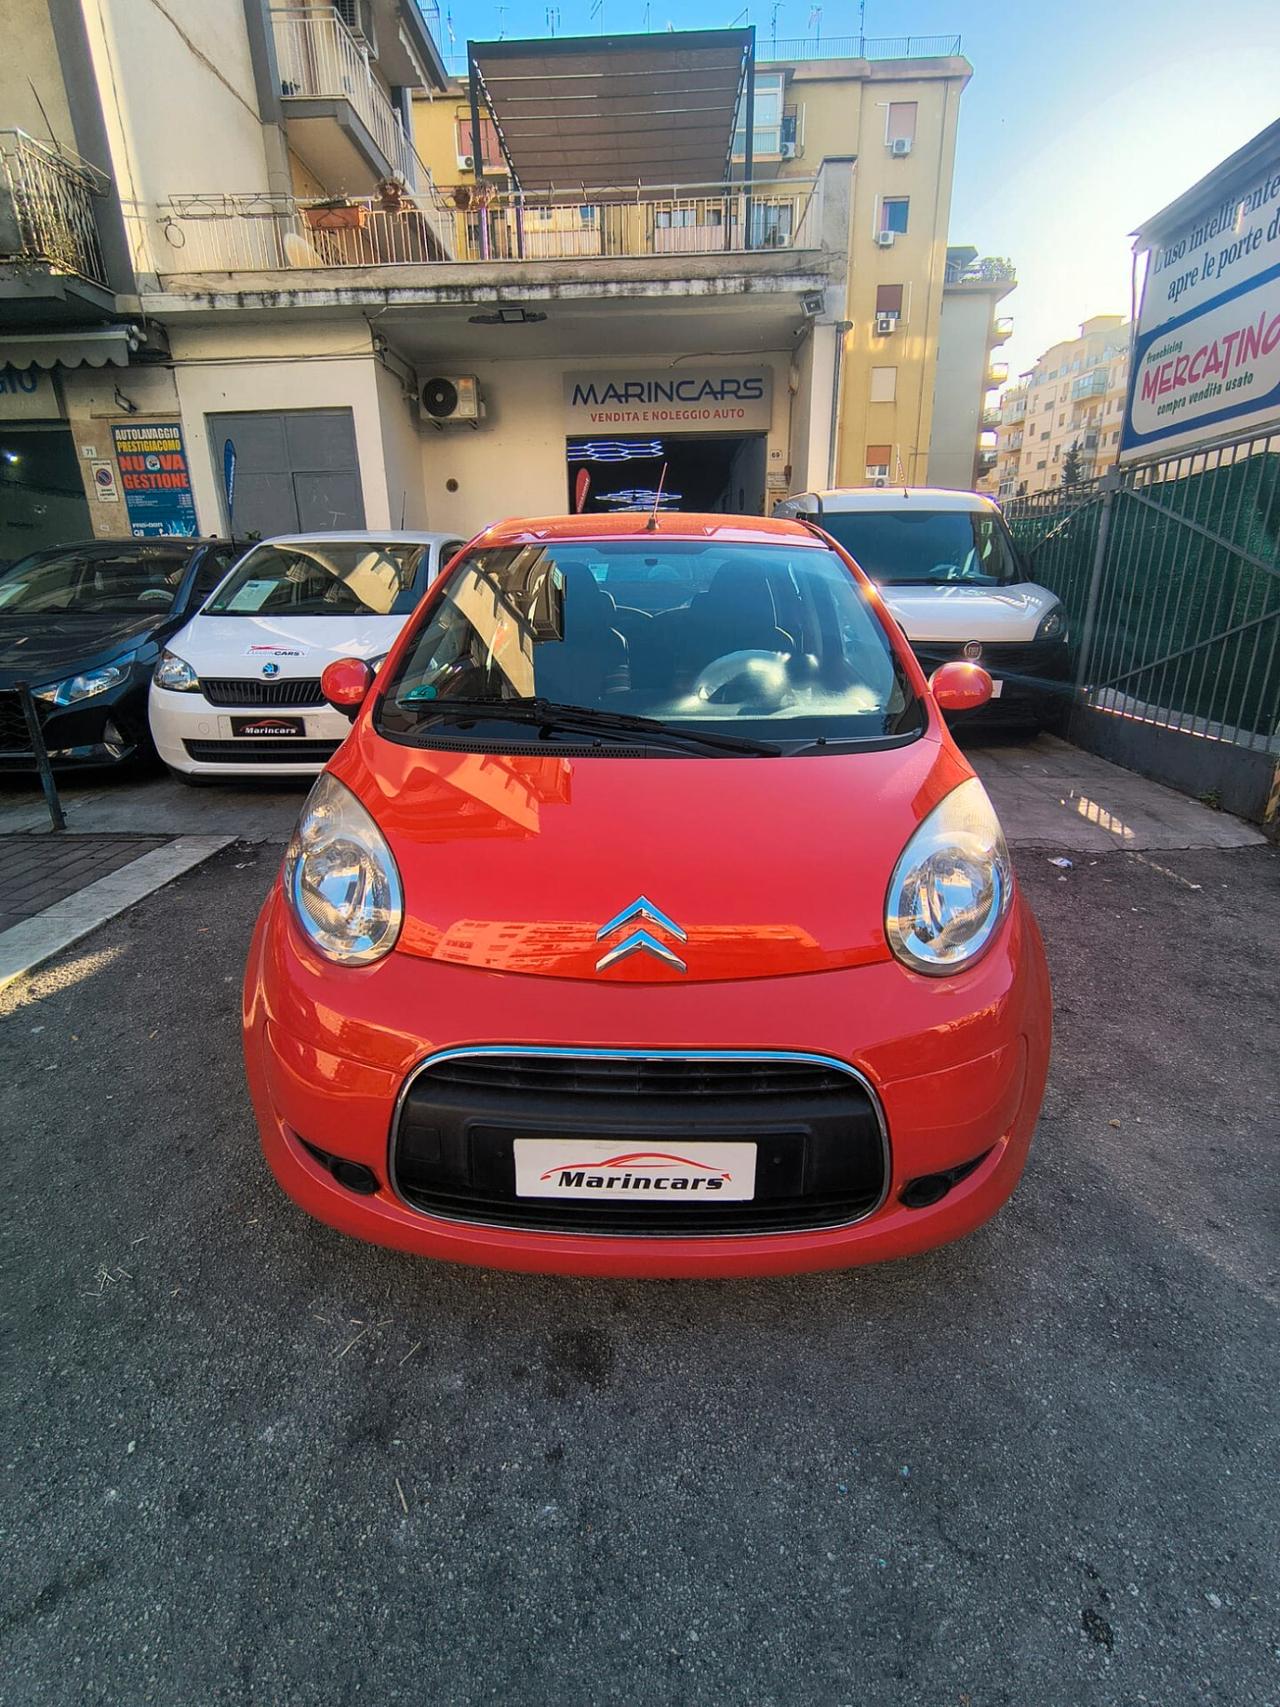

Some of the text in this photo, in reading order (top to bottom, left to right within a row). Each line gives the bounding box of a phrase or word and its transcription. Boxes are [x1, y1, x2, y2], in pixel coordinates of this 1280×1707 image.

[1168, 265, 1198, 303] apre
[1201, 252, 1215, 280] le
[1216, 225, 1263, 278] porte
[1147, 340, 1183, 364] franchising
[572, 377, 763, 405] MARINCARS
[1157, 371, 1254, 416] compra vendita usato
[590, 408, 745, 422] VENDITA E NOLEGGIO AUTO
[115, 428, 180, 440] AUTOLAVAGGIO
[117, 439, 181, 452] PRESTIGIACOMO
[123, 473, 189, 489] GESTIONE
[245, 726, 297, 734] Marincars
[558, 1171, 724, 1191] Marincars
